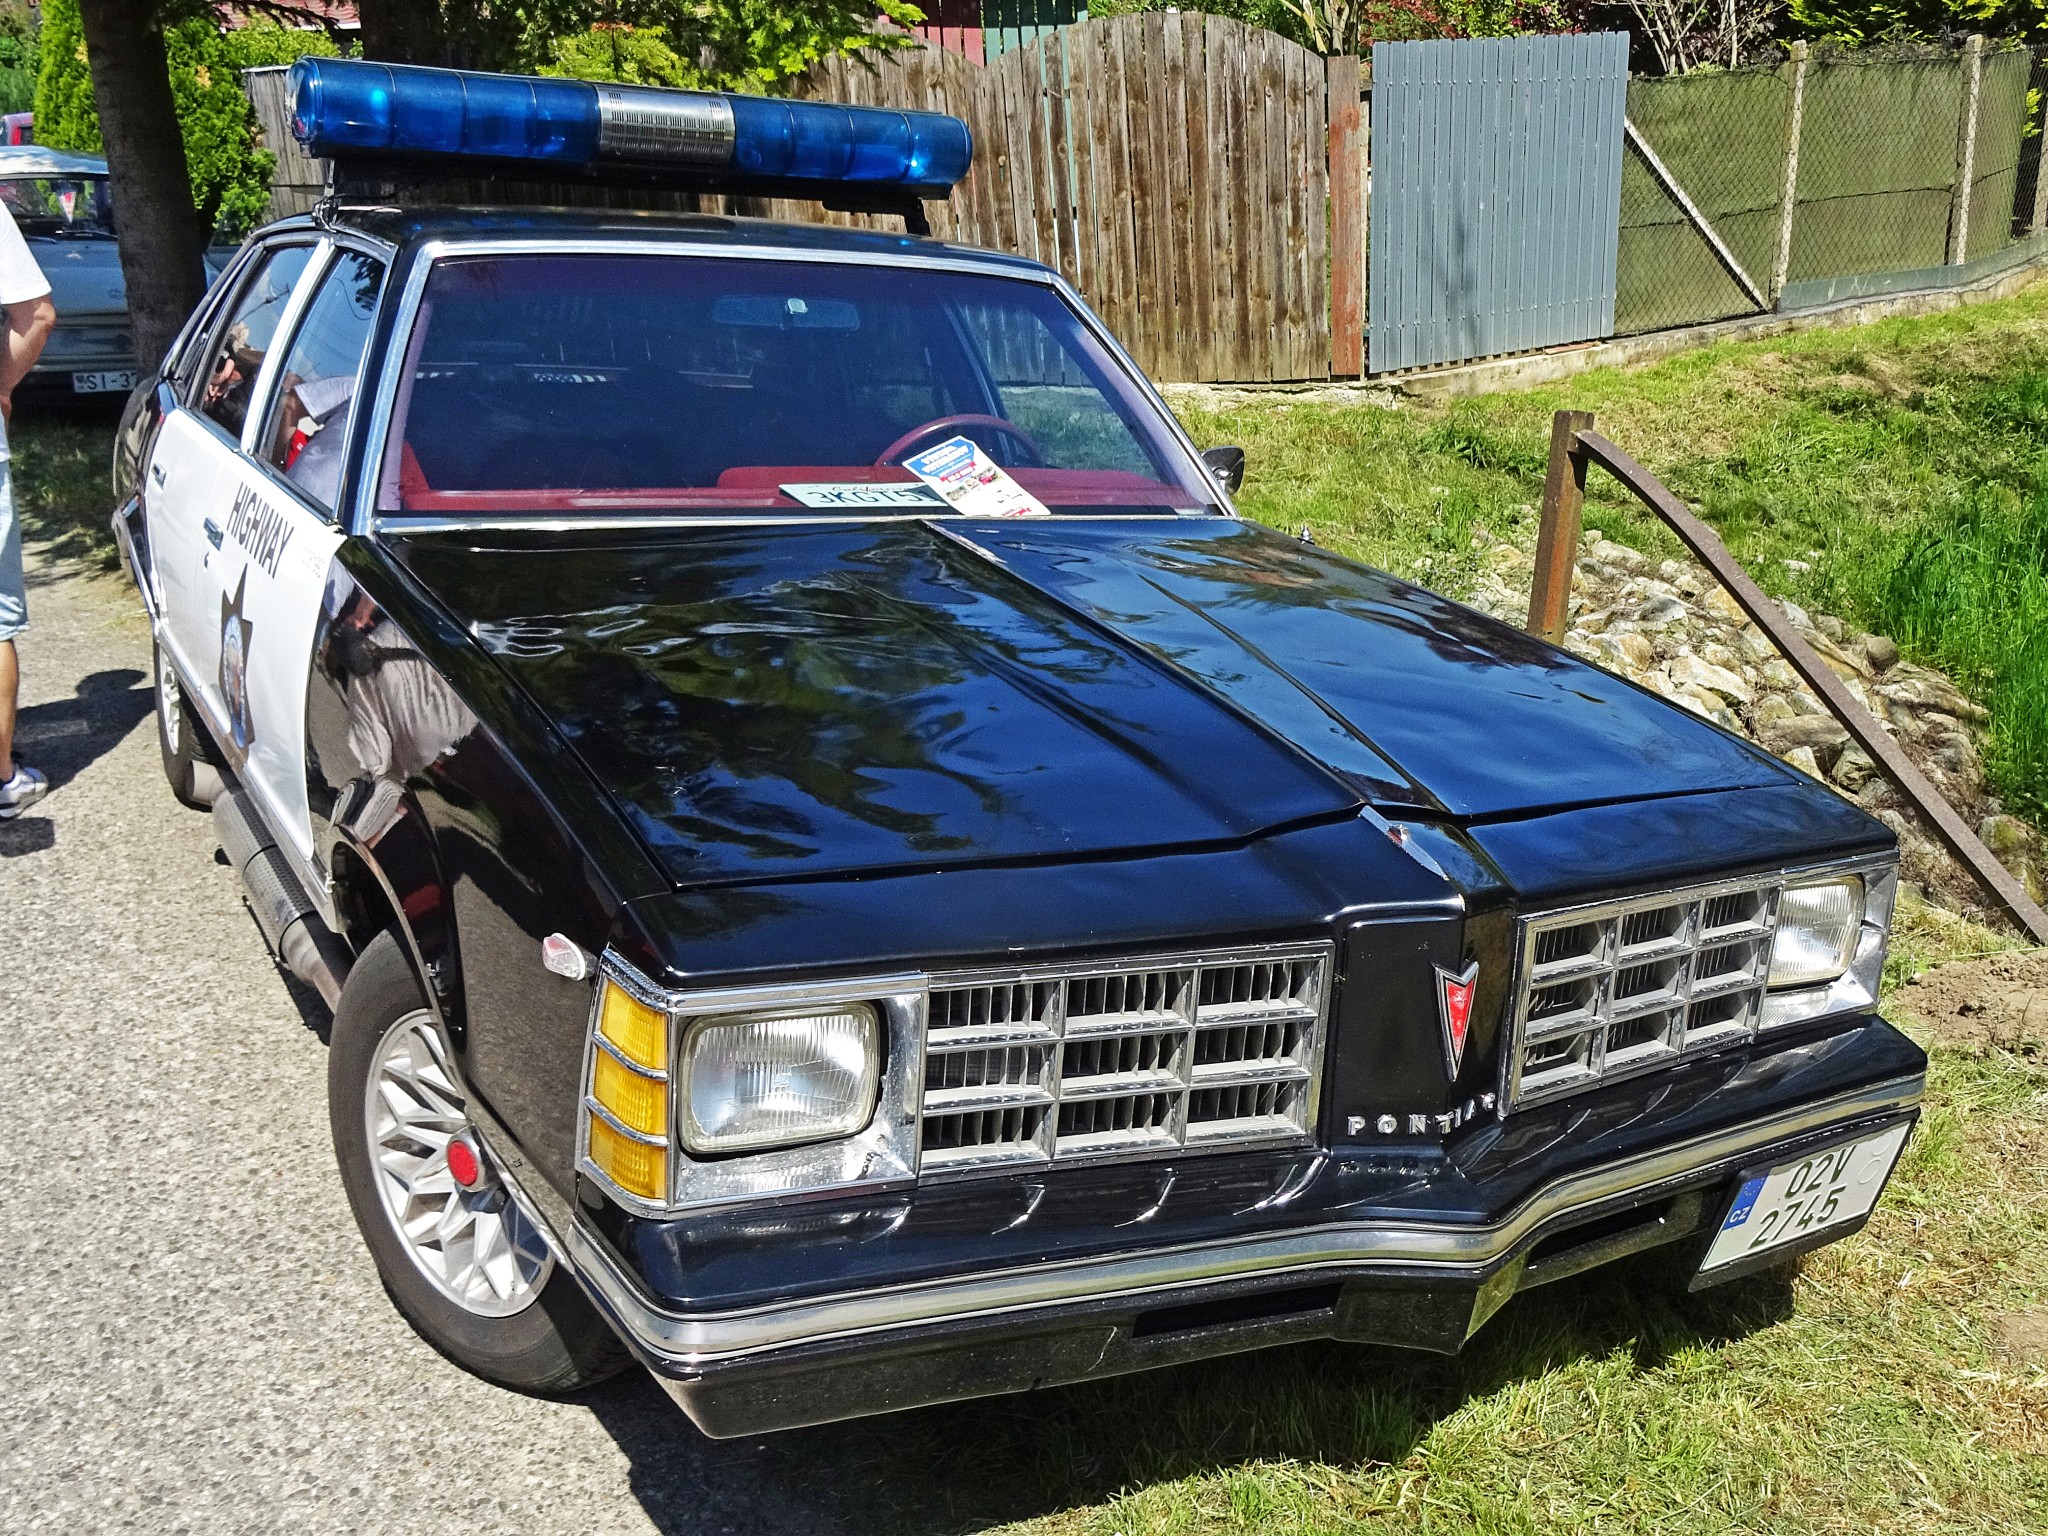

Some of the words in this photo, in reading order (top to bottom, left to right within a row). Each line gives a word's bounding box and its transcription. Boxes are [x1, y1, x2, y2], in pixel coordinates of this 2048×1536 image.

[226, 481, 294, 580] HIGHWAY
[1347, 1092, 1496, 1136] PONTIAC
[1784, 1144, 1858, 1200] 02V
[1729, 1205, 1751, 1224] CZ
[1748, 1184, 1847, 1250] 2745
